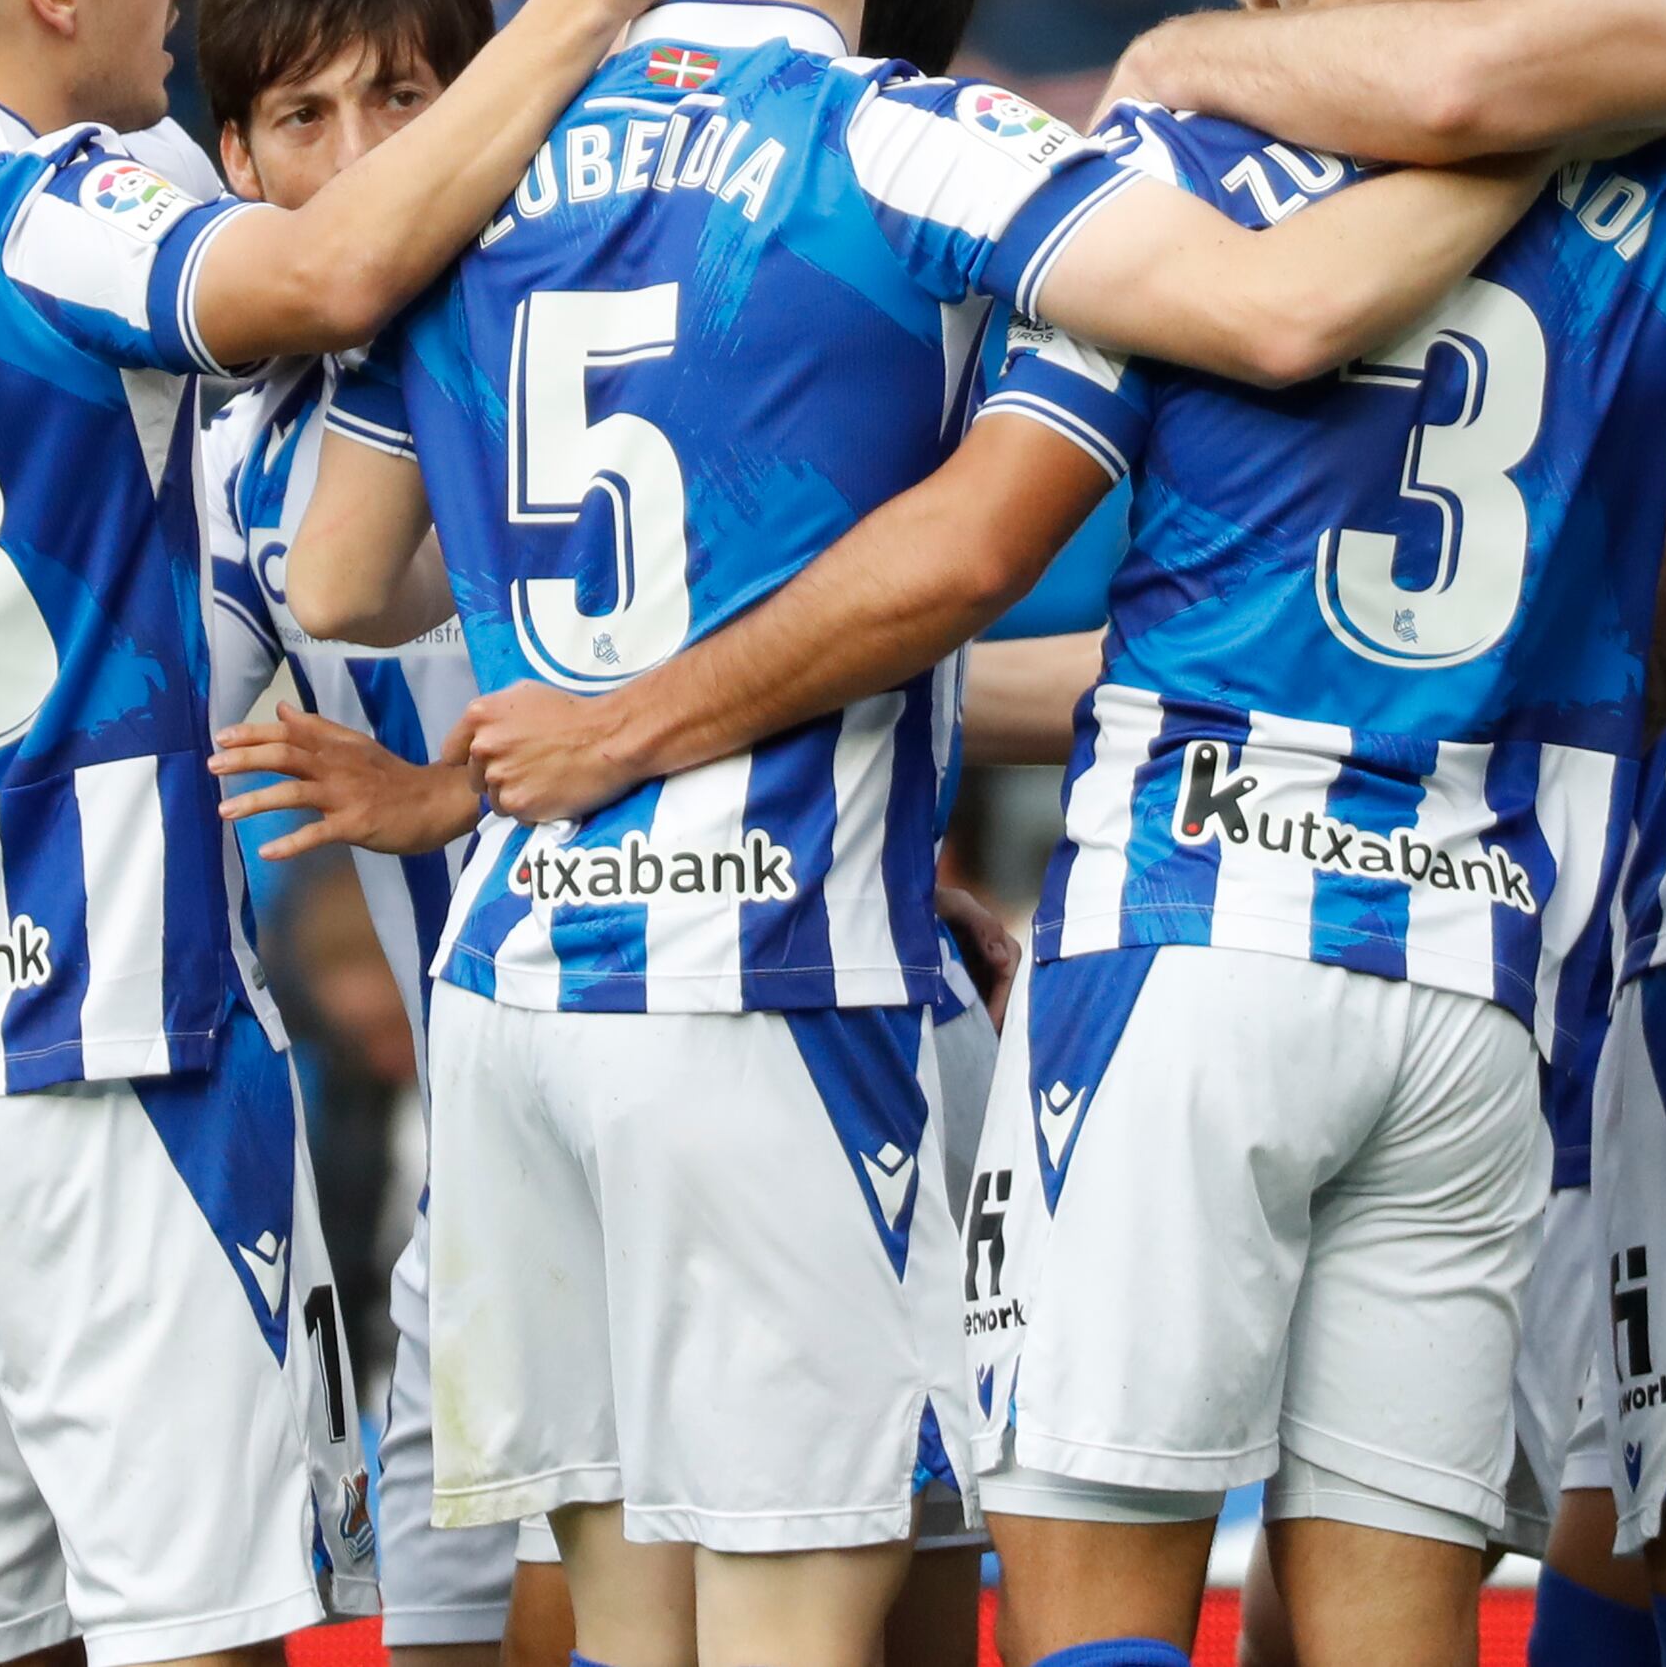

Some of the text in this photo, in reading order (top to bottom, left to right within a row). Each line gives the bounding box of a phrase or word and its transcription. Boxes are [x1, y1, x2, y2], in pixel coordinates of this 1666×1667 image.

[508, 282, 691, 684] 5
[1315, 277, 1546, 668] 3
[517, 837, 789, 900] txabank
[1183, 743, 1531, 907] Kutxabank
[963, 1298, 1027, 1337] etwork
